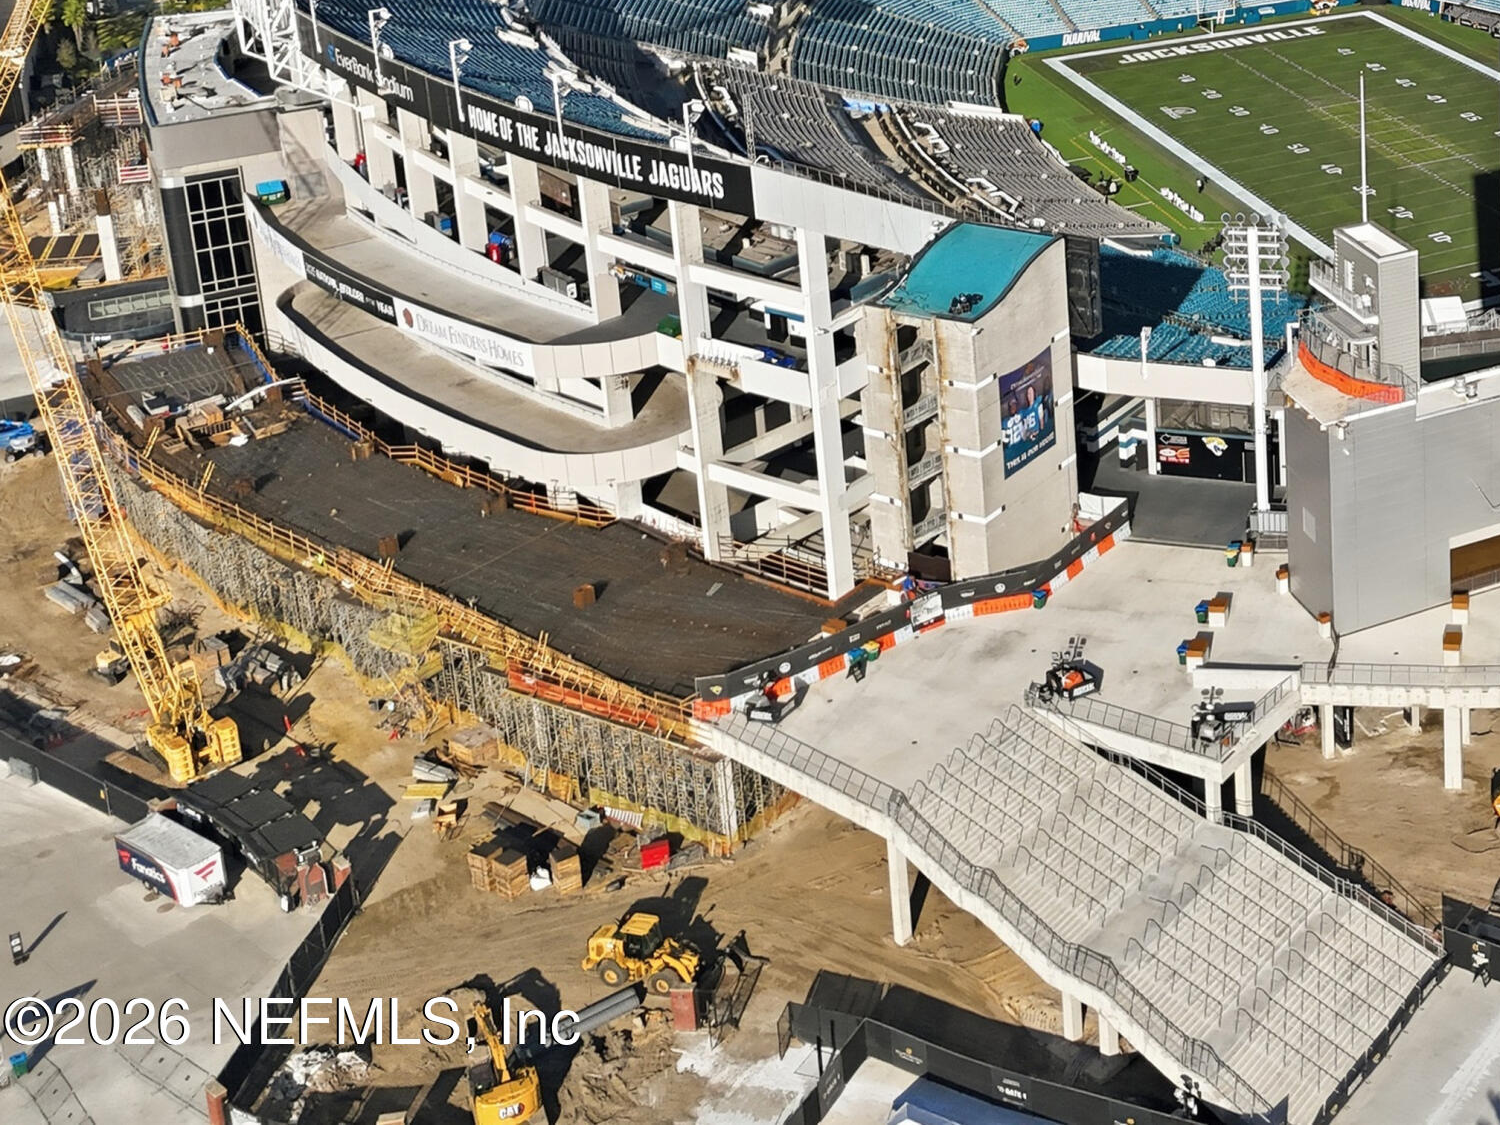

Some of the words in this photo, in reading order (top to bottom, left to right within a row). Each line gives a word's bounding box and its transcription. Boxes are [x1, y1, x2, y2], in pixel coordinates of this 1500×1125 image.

[1118, 24, 1326, 65] JACKSONVILLE
[334, 47, 374, 84] EverBank
[468, 104, 500, 139] HOME
[499, 117, 514, 144] OF
[516, 121, 541, 152] THE
[543, 130, 644, 182] JACKSONVILLE
[649, 159, 725, 199] JAGUARS
[1286, 142, 1311, 155] 50
[1387, 206, 1414, 220] 20
[1427, 231, 1453, 244] 10
[131, 857, 167, 884] Fanatics
[498, 1102, 520, 1120] CAT
